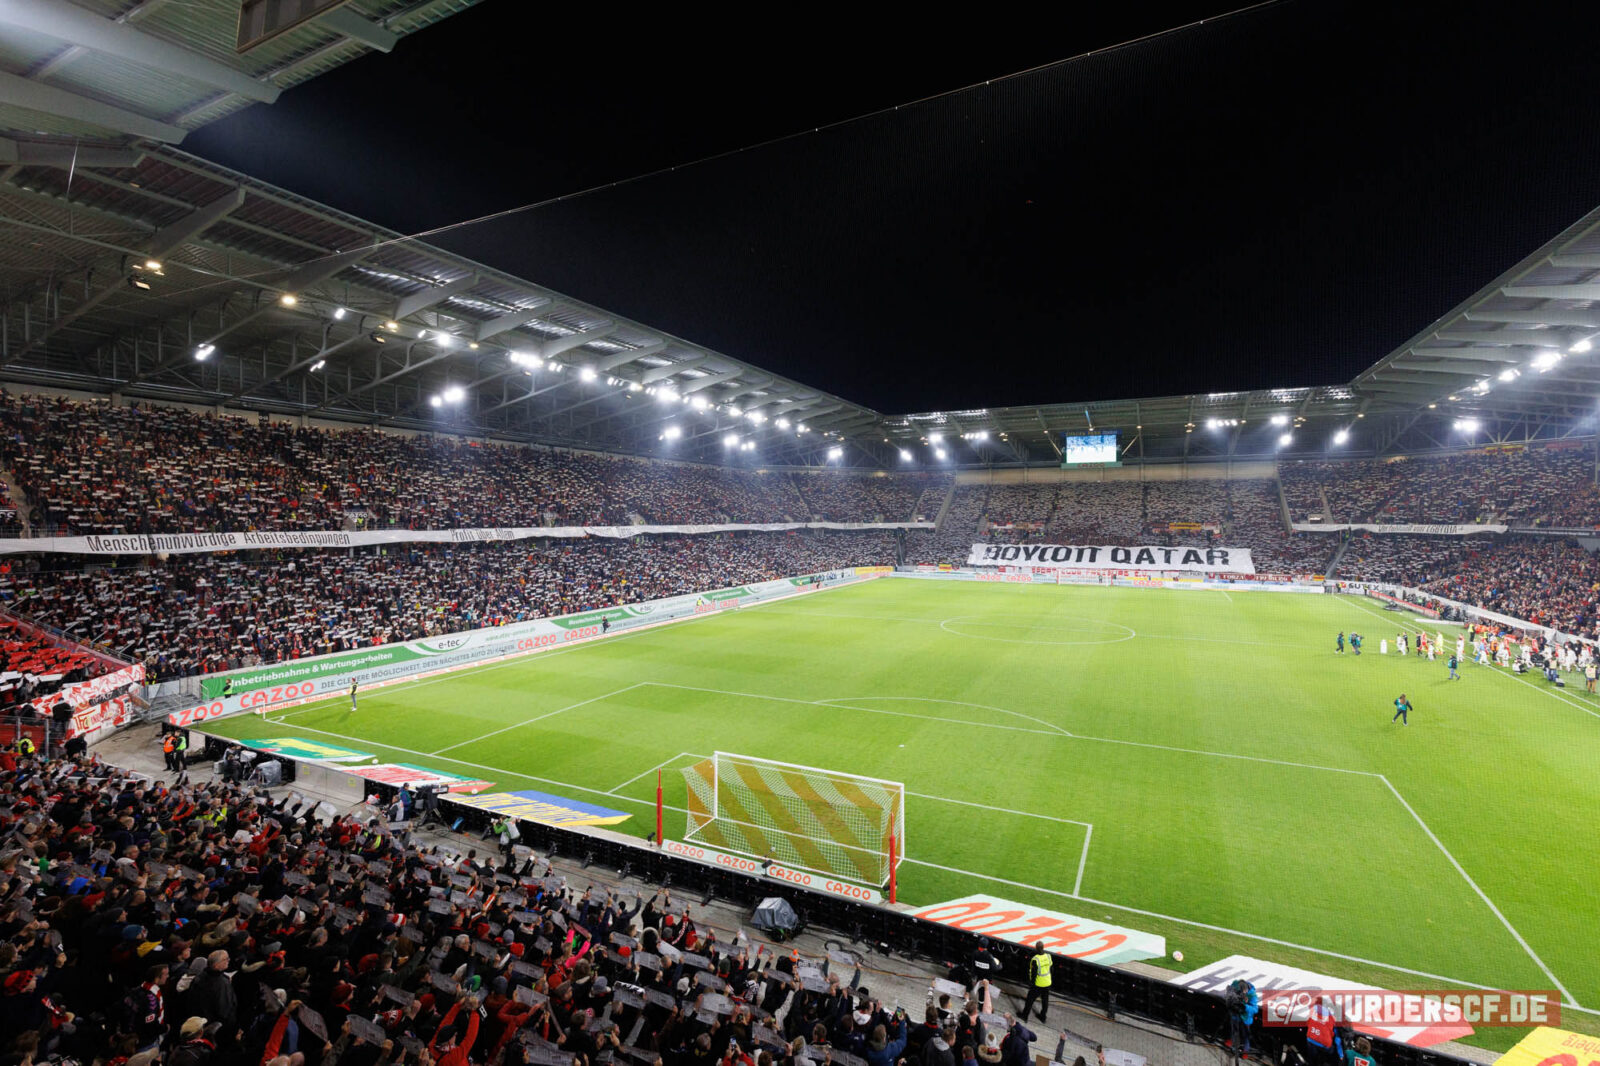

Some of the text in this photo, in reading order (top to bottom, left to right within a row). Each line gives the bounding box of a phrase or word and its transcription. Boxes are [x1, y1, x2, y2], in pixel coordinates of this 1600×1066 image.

[87, 531, 351, 552] Menschenunwürdige Arbeitsbedingungen
[983, 546, 1229, 566] BOYCOTT QATAR
[438, 639, 461, 649] e-tec
[517, 626, 599, 651] CAZOO CAZOO
[231, 652, 393, 687] Inbetriebnahme & Wartungsarbeiten
[240, 682, 315, 709] CAZOO
[321, 681, 335, 689] DIE
[667, 840, 756, 873] CAZOO CAZOO
[769, 866, 871, 901] CAZOO CAZOO
